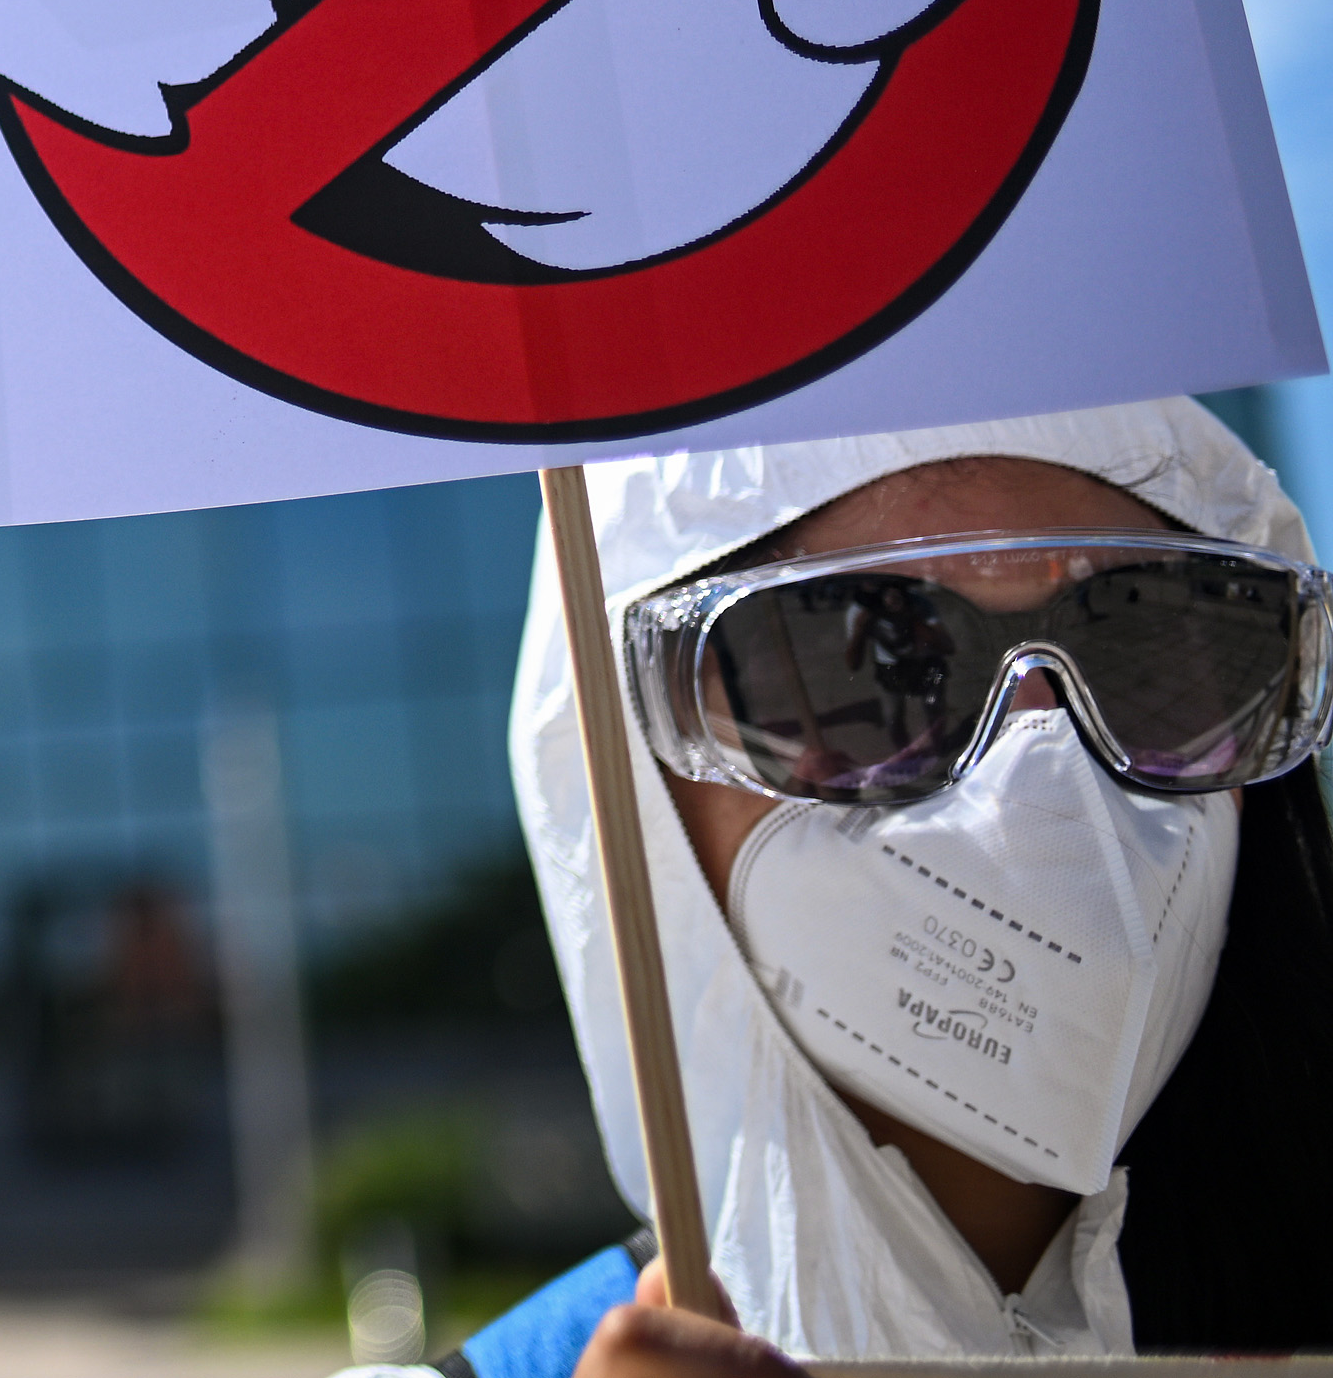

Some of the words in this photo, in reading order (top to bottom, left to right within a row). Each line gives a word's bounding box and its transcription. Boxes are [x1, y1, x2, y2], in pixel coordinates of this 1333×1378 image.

[924, 915, 977, 958] 0370
[915, 961, 948, 986] FFP2
[897, 987, 1012, 1065] EUROPAPA
[979, 997, 1034, 1033] EA1688
[1018, 1001, 1038, 1019] EN
